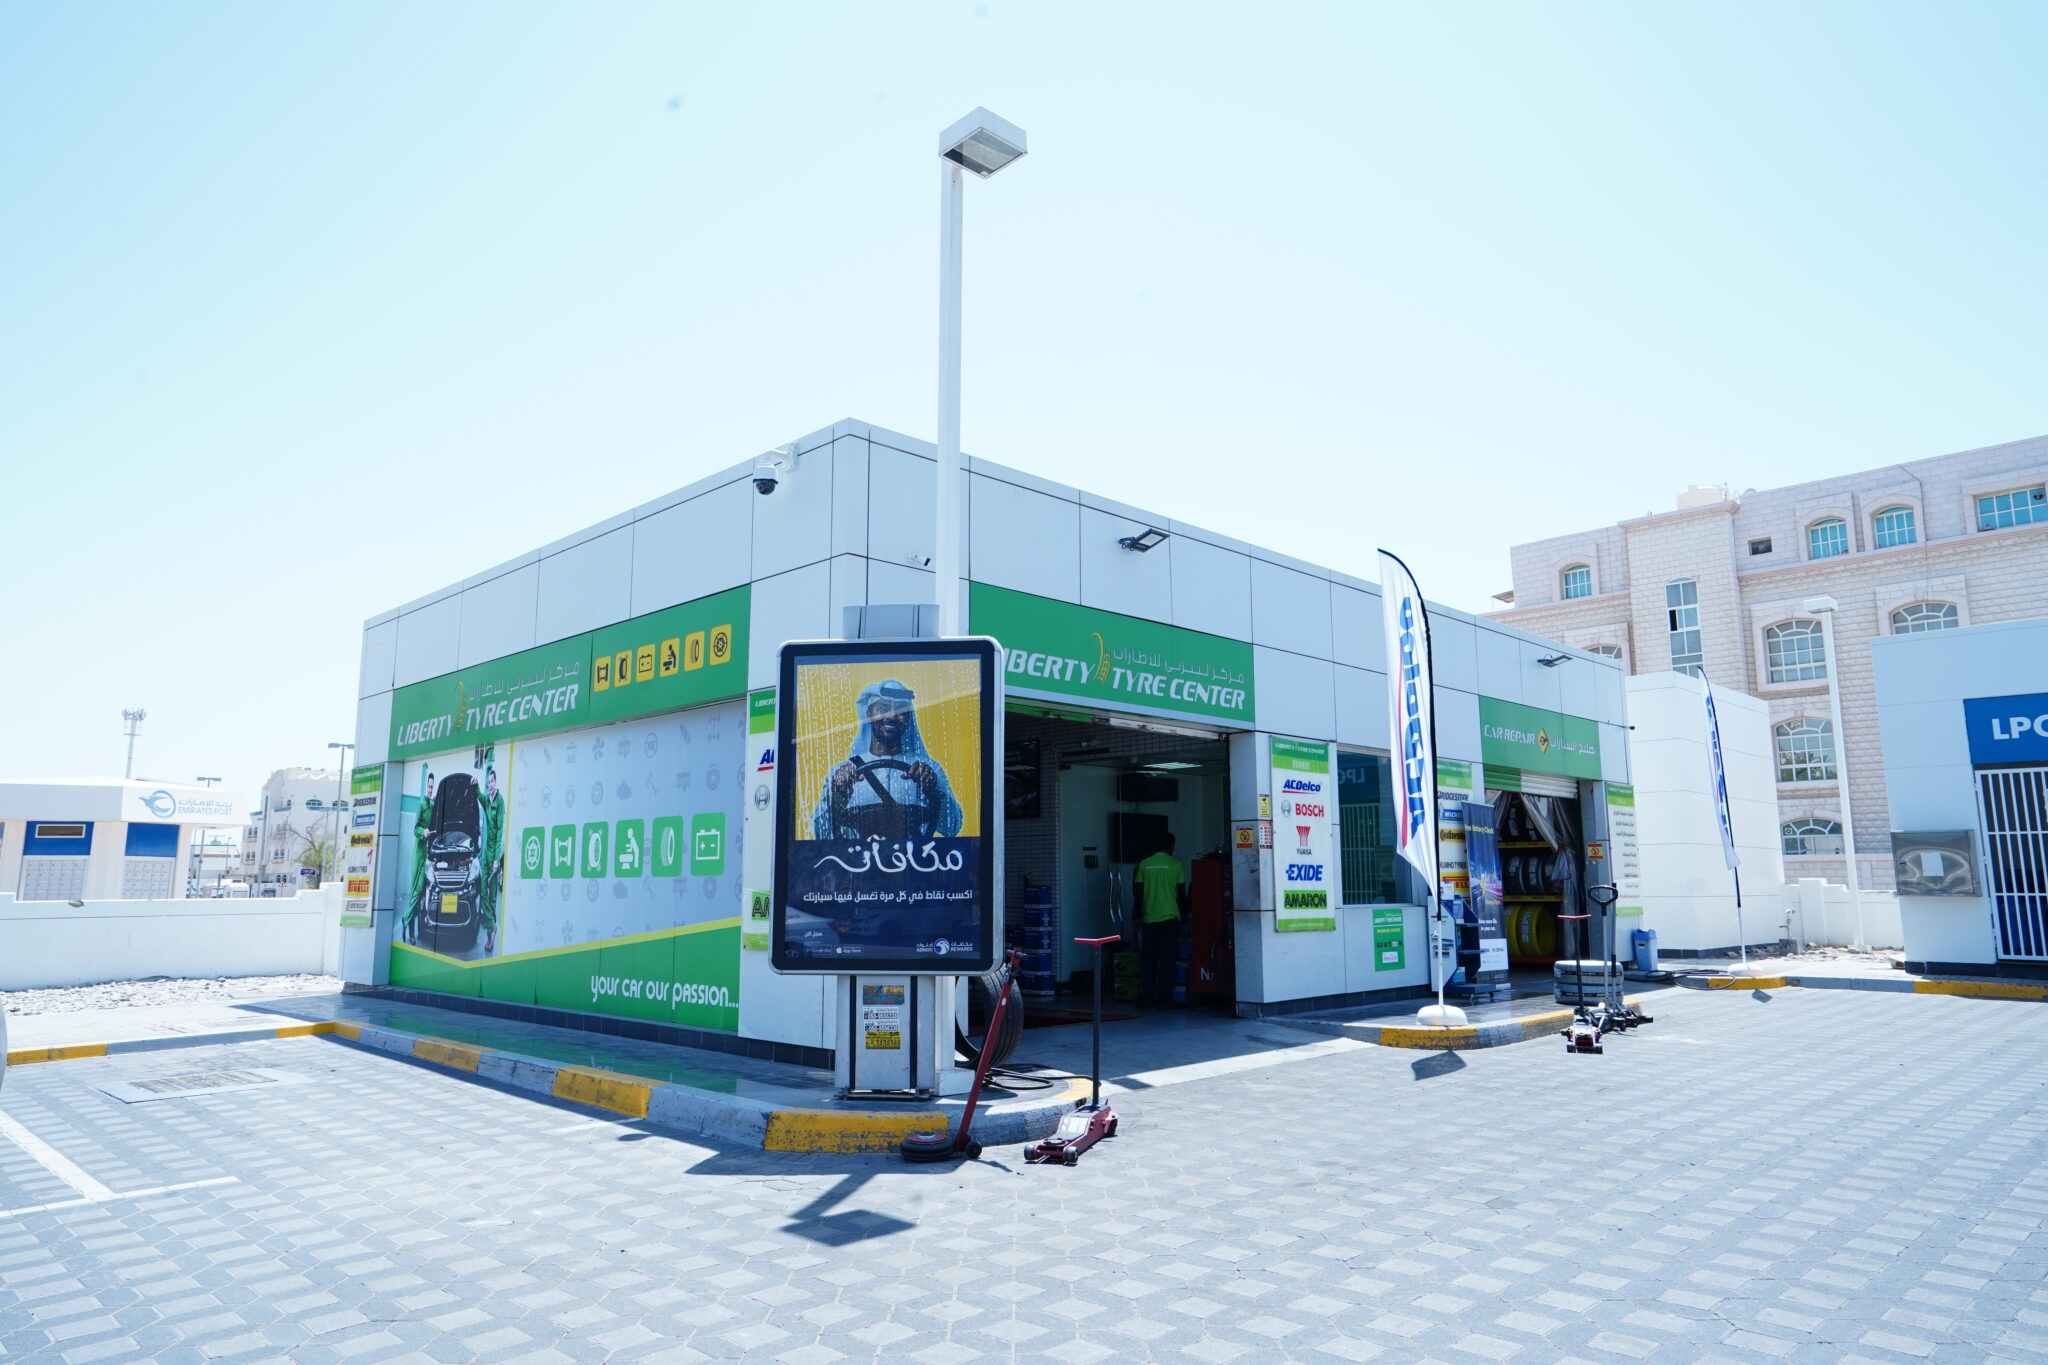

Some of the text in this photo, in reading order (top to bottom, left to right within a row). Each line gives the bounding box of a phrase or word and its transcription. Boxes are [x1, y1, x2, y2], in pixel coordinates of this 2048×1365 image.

[1004, 648, 1246, 710] IBERTY TYRE CENTER
[397, 684, 579, 746] LIBERTY TYRE CENTER
[1484, 725, 1536, 745] CAR REPAIR
[1283, 779, 1321, 792] ACDelco
[178, 806, 233, 816] EMIRATES POST
[1295, 803, 1325, 817] BOSCH
[1286, 863, 1323, 881] EXIDE
[803, 889, 973, 905] اكسب نقاط في كل مرة تغسل فيها سيارتك
[1284, 893, 1327, 908] AMARON
[591, 975, 739, 1010] your car our passion...
